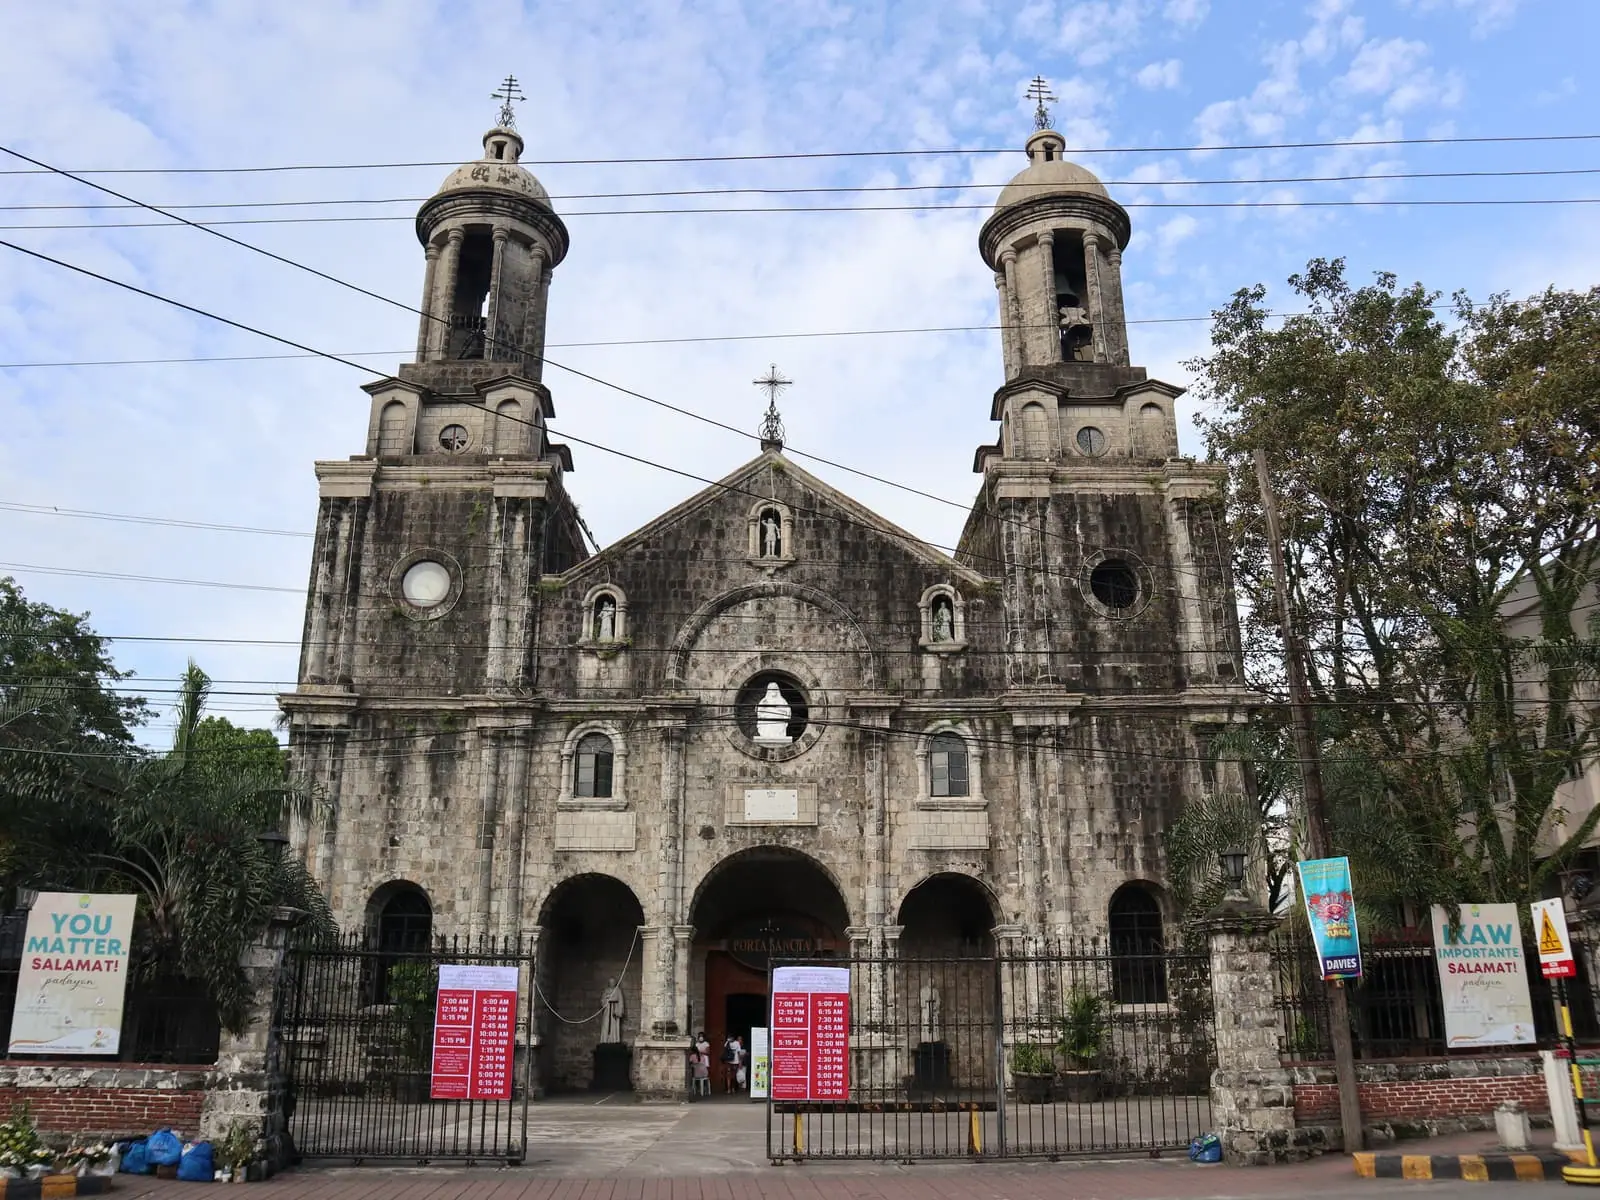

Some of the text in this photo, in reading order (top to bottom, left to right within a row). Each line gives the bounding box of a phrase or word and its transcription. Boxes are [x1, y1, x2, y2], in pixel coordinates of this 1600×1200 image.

[51, 913, 112, 935] YOU
[1442, 924, 1512, 945] IKAW
[27, 936, 126, 955] MATTER.
[733, 939, 767, 952] PORTA
[1438, 947, 1522, 958] IMPORTANTE.
[32, 958, 119, 972] SALAMAT!
[1326, 958, 1357, 970] DAVIES
[1448, 962, 1518, 973] SALAMAT!
